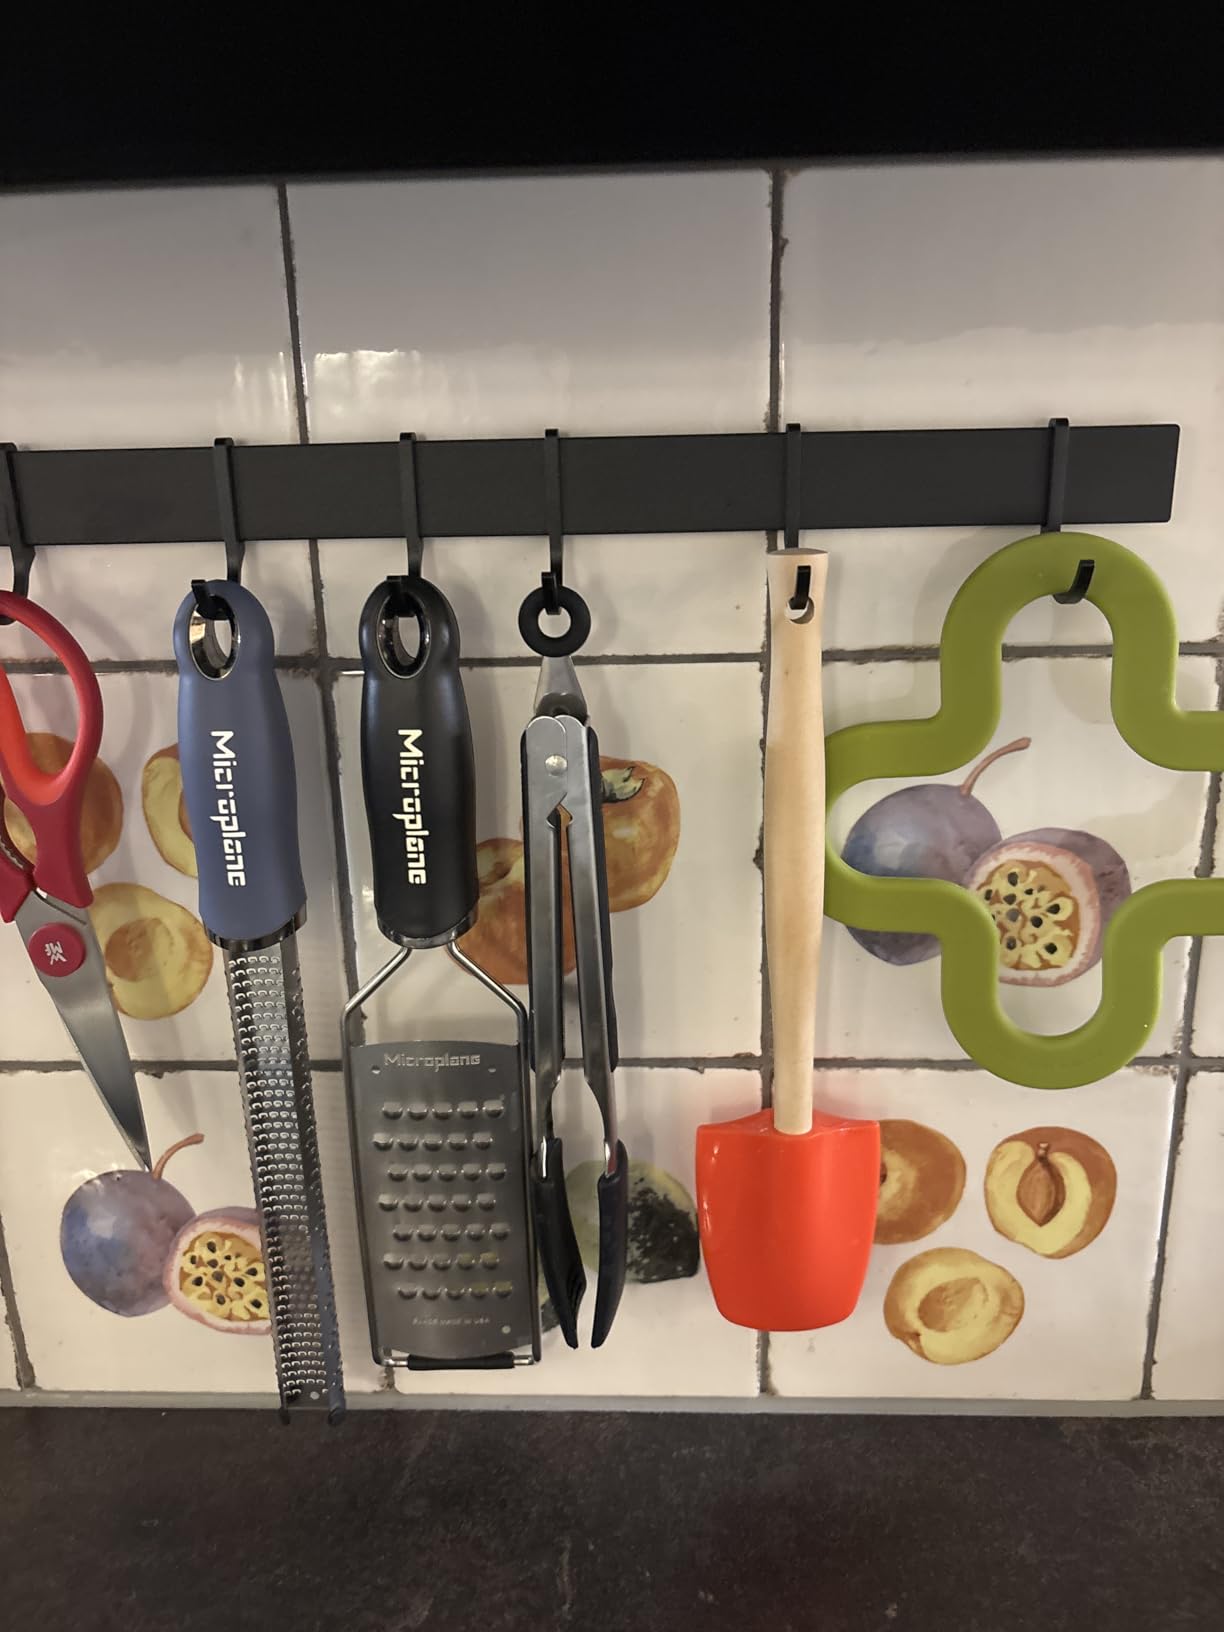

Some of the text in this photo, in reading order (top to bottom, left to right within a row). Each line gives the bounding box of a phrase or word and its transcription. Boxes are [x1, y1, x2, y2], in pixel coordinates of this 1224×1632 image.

[209, 730, 247, 887] Microplane
[393, 728, 430, 885] Microplane
[384, 1052, 481, 1073] Microplane
